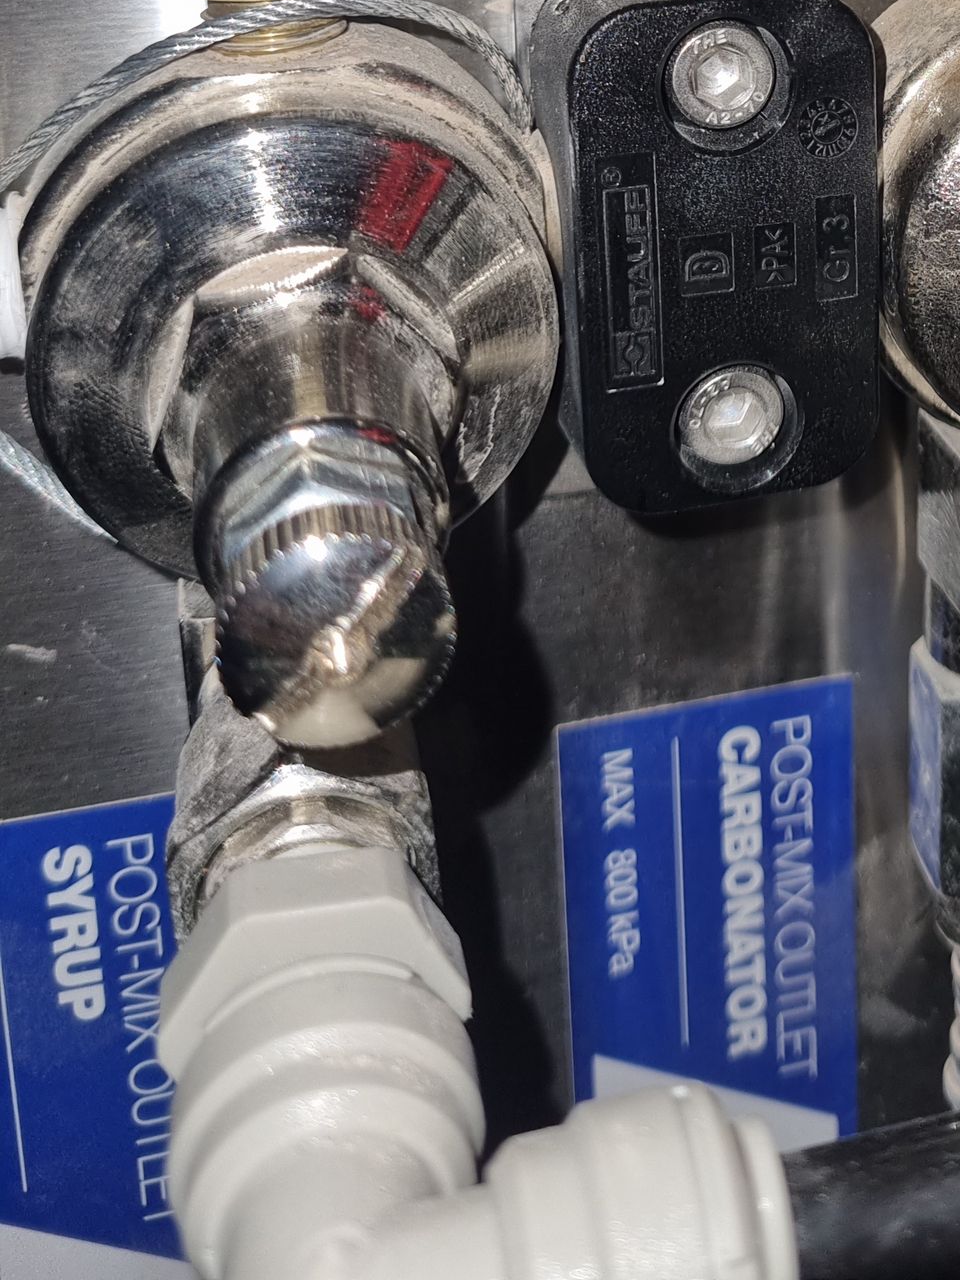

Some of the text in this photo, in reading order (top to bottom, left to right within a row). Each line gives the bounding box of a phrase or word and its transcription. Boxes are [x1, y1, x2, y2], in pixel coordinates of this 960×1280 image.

[624, 190, 651, 330] STAUFF
[602, 747, 636, 833] MAX
[41, 844, 107, 1022] SYRUP
[106, 832, 166, 1054] POST-MIX
[717, 724, 768, 1063] CARBONATOR
[770, 714, 818, 1081] POST-MIX OUTLET
